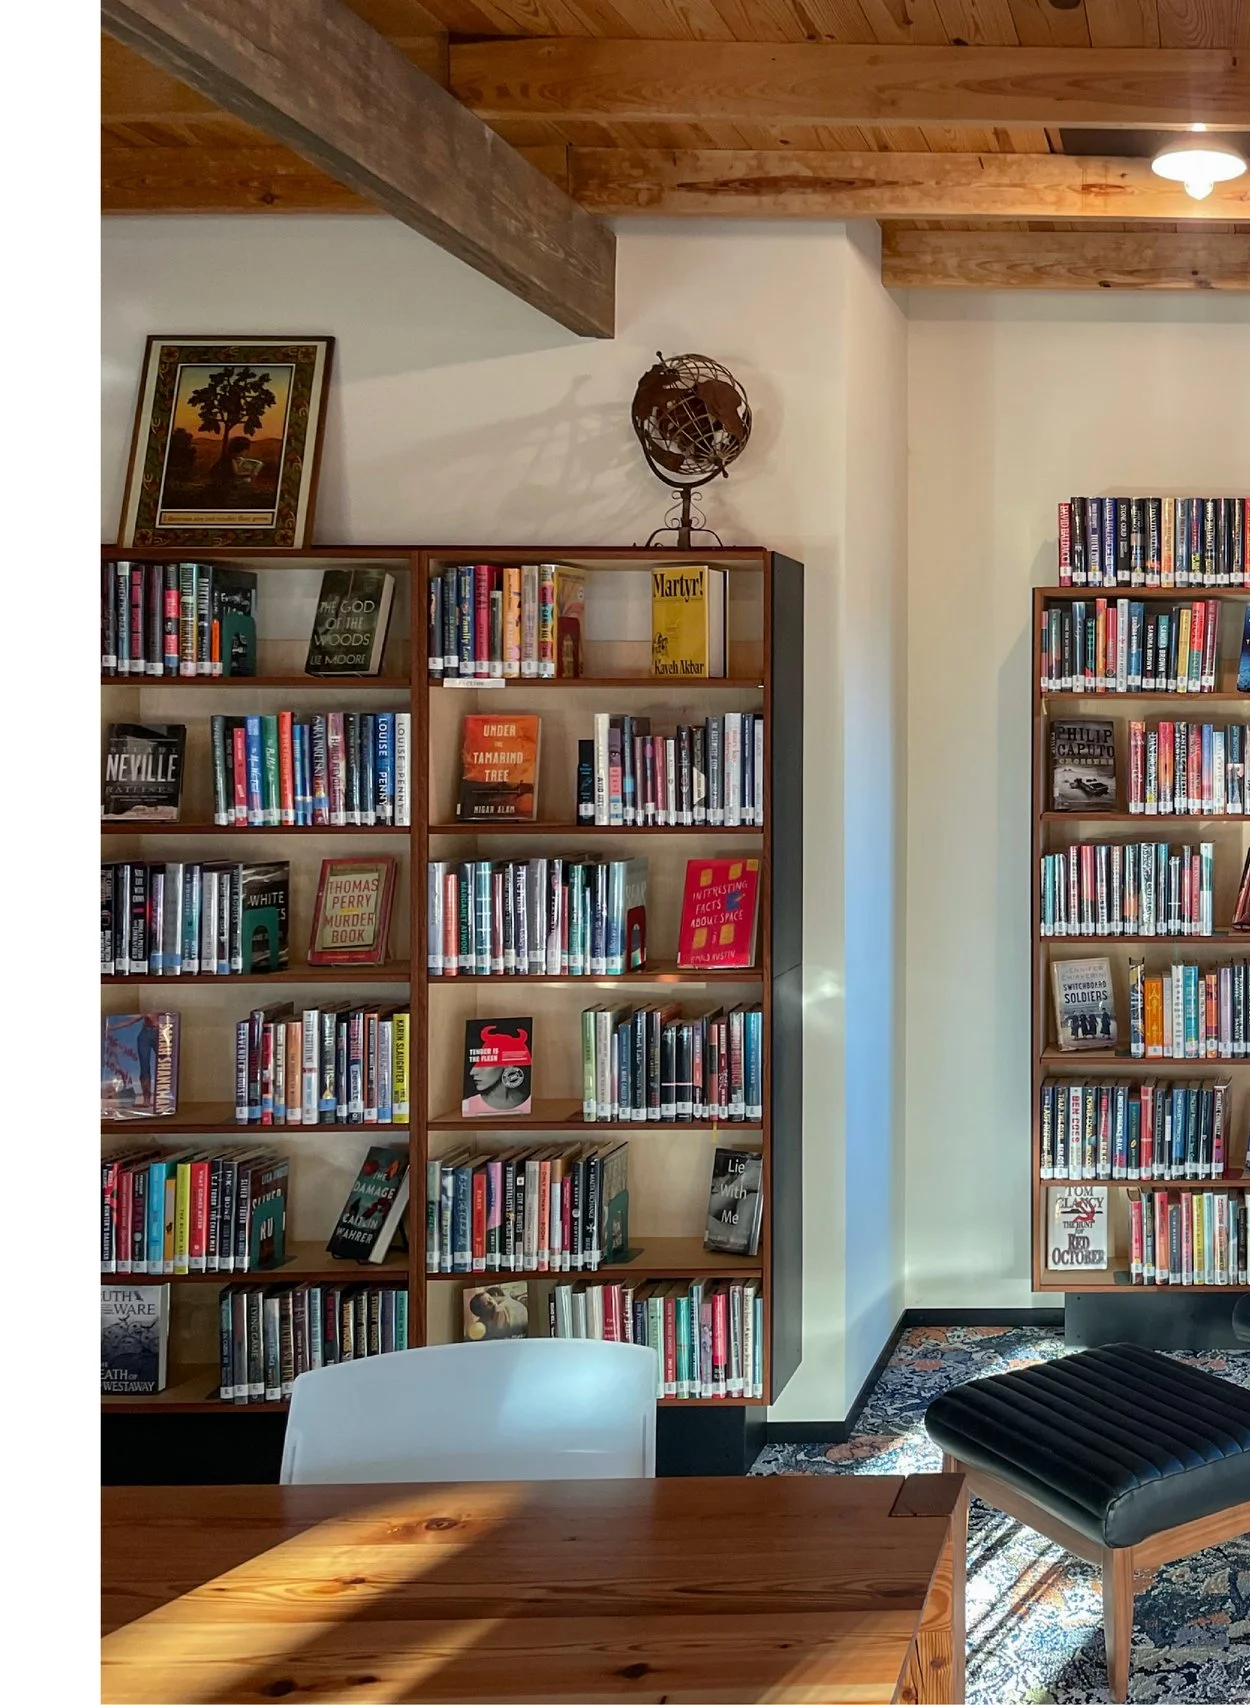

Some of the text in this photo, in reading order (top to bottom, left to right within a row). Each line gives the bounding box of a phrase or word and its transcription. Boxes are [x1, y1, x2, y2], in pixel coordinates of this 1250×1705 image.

[1060, 505, 1070, 563] DAVID BALDACCI
[652, 573, 704, 602] Martyr!
[319, 600, 375, 613] THE GOD
[326, 617, 364, 629] OF THE
[314, 633, 370, 647] WOODS
[310, 653, 366, 665] LIZ MOORE
[655, 660, 704, 675] Kaveh Akbar
[483, 724, 516, 737] UNDER
[1057, 727, 1113, 743] PHILIP
[1057, 743, 1115, 758] CAPUTO
[378, 718, 388, 806] LOUISE PENNY
[397, 723, 405, 808] LOUISE PENNY
[473, 752, 523, 765] TAMARIND
[106, 754, 178, 782] NEVILLE
[485, 769, 510, 783] TREE
[328, 879, 379, 893] THOMAS
[693, 880, 748, 900] INTERESTING
[250, 892, 285, 906] WHITE
[332, 895, 372, 908] PERRY
[460, 882, 468, 923] MARGARET
[695, 900, 721, 914] FACTS
[325, 914, 375, 927] MURDER
[720, 911, 744, 922] SPACE
[331, 929, 365, 943] BOOK
[1063, 981, 1107, 991] SWITCHBOARD
[1064, 990, 1107, 1004] SOLDIERS
[396, 1020, 405, 1083] KARIN SLAUGHTER
[156, 1055, 173, 1112] SHANKMAN
[728, 1159, 745, 1174] Lie
[354, 1183, 394, 1198] DAMAGE
[720, 1183, 747, 1200] With
[1067, 1187, 1093, 1196] TOM
[1055, 1197, 1104, 1209] CLANCY
[721, 1212, 739, 1225] Me
[337, 1227, 374, 1244] WAHRER
[1067, 1235, 1090, 1250] RED
[1052, 1248, 1104, 1265] OCTOBER
[114, 1304, 156, 1315] WARE
[343, 1303, 351, 1352] STUART WOODS
[103, 1381, 155, 1392] WESTAWAY
